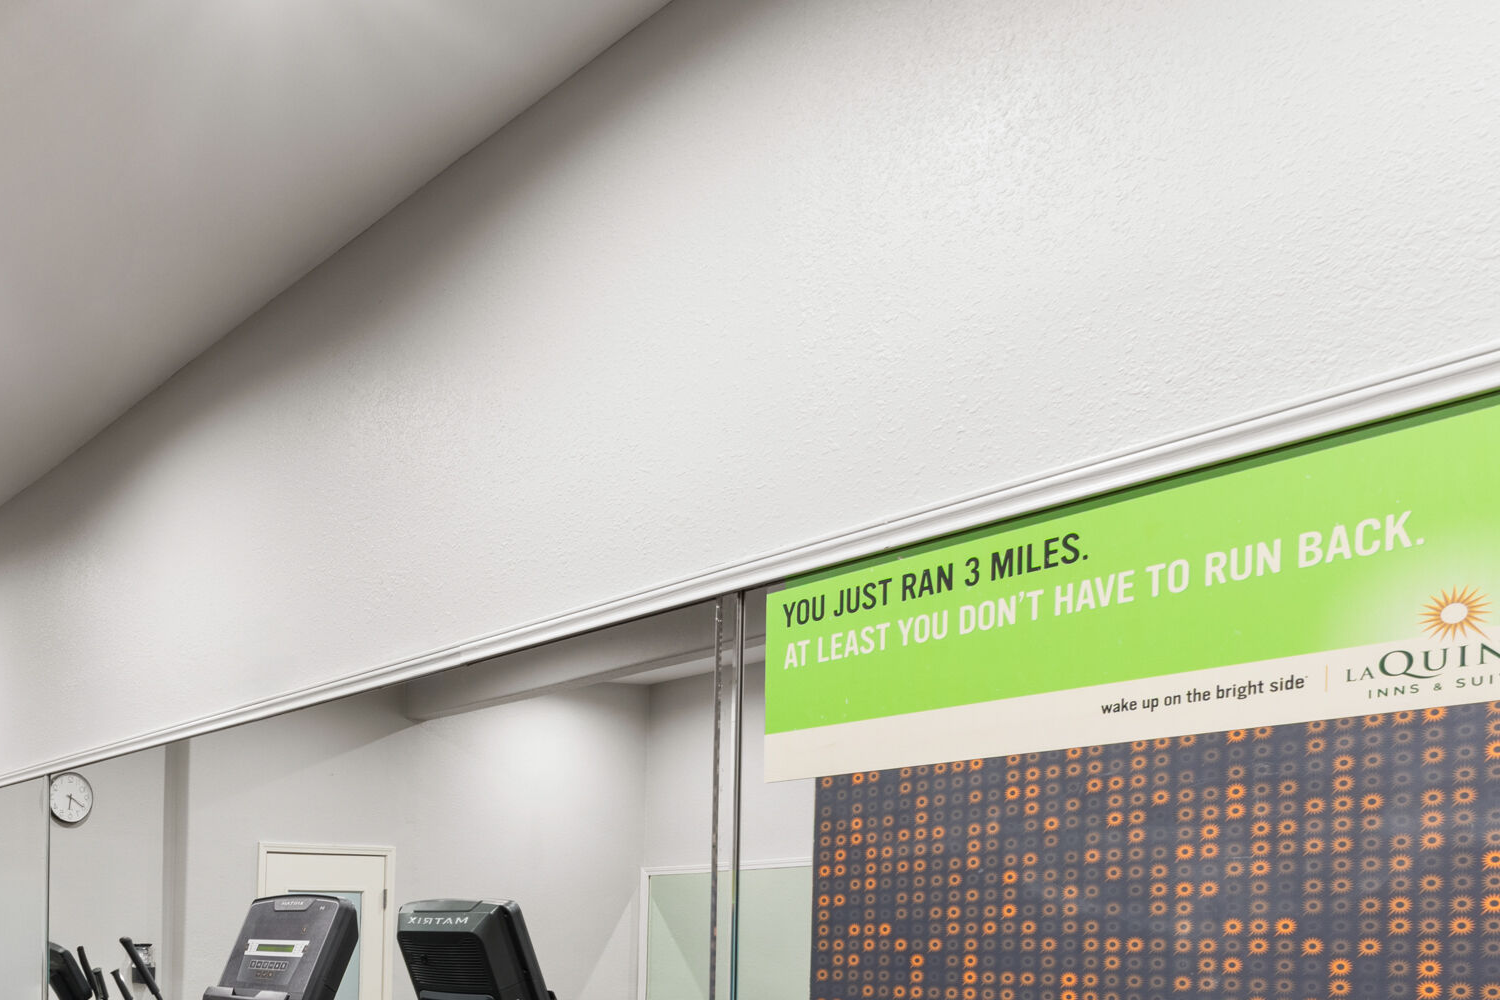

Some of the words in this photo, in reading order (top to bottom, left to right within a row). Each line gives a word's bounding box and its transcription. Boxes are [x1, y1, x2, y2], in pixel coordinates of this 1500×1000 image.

[783, 594, 826, 628] YOU
[833, 577, 893, 618] JUST
[901, 563, 954, 602] RAN
[964, 556, 980, 586] 3
[990, 533, 1088, 581] MILES.
[783, 639, 811, 670] AT
[817, 622, 891, 663] LEAST
[898, 609, 949, 647] YOU
[958, 589, 1045, 635] DON'T
[1053, 569, 1135, 617] HAVE
[1145, 558, 1190, 598] TO
[1204, 538, 1282, 587] RUN
[1297, 510, 1425, 569] BACK.
[1101, 698, 1138, 715] wake
[1142, 696, 1159, 712] up
[1164, 692, 1182, 706] on
[1186, 687, 1211, 703] the
[1216, 680, 1265, 700] bright
[1269, 674, 1305, 692] side
[1367, 683, 1420, 699] INNS
[1433, 682, 1443, 692] &
[1455, 672, 1500, 689] SUI
